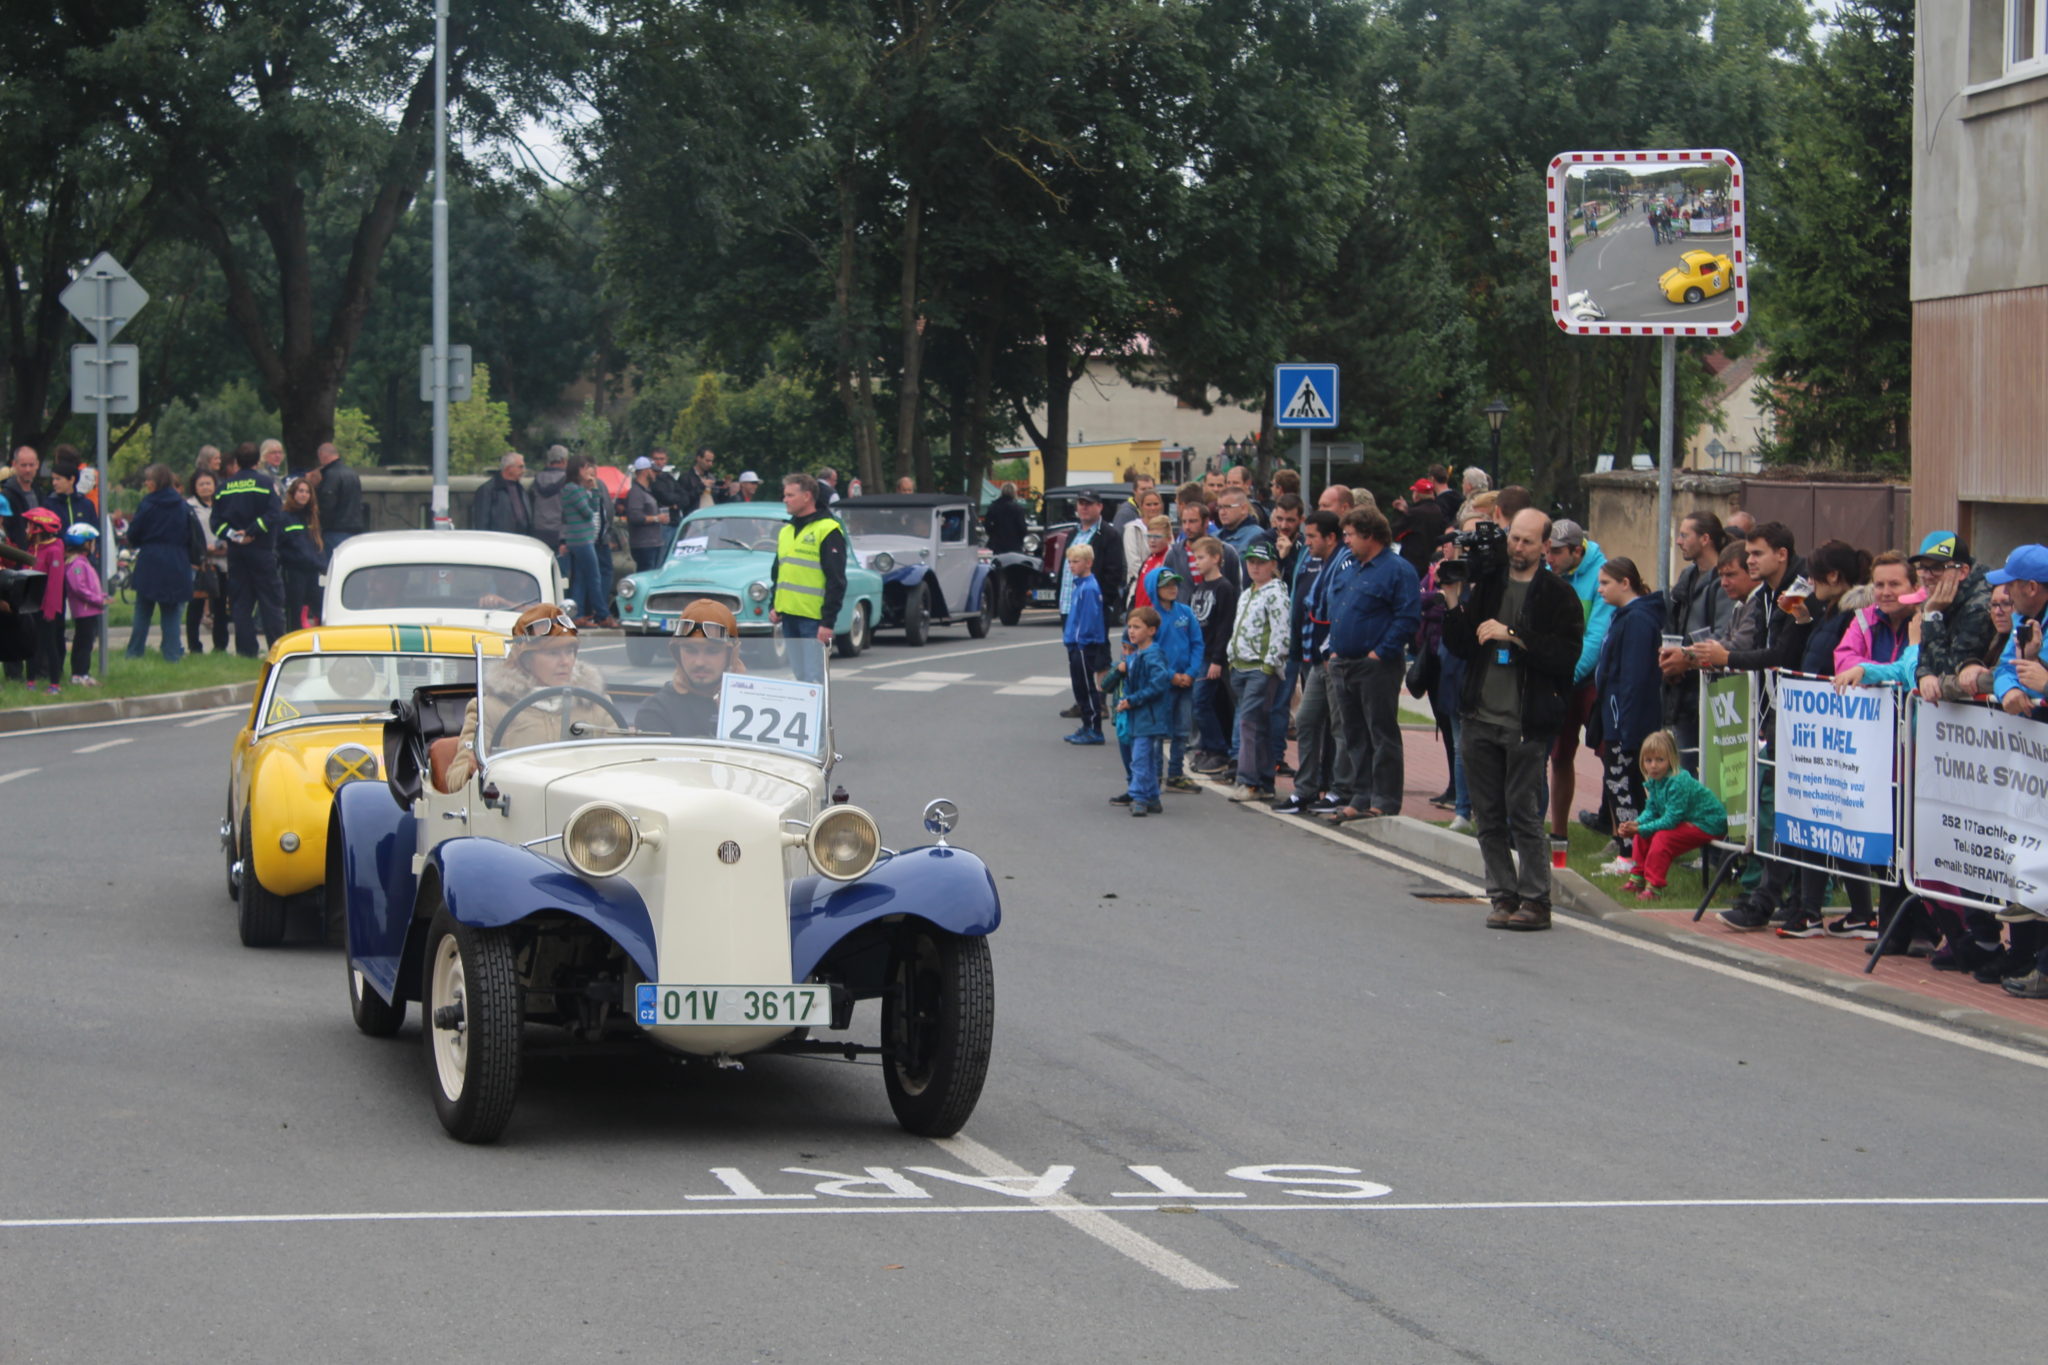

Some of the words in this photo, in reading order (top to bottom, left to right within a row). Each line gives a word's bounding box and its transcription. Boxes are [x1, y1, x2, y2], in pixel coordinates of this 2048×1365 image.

[729, 704, 809, 747] 224
[1792, 722, 1816, 748] Jiří
[1787, 820, 1808, 846] Tel.:
[1810, 825, 1831, 851] 311
[1846, 834, 1865, 860] 147
[1942, 814, 1961, 829] 252
[2021, 834, 2042, 851] 171
[718, 840, 741, 864] TATRA
[641, 1011, 655, 1020] CZ
[664, 990, 718, 1020] 01V
[744, 990, 815, 1020] 3617
[684, 1164, 1393, 1199] START
